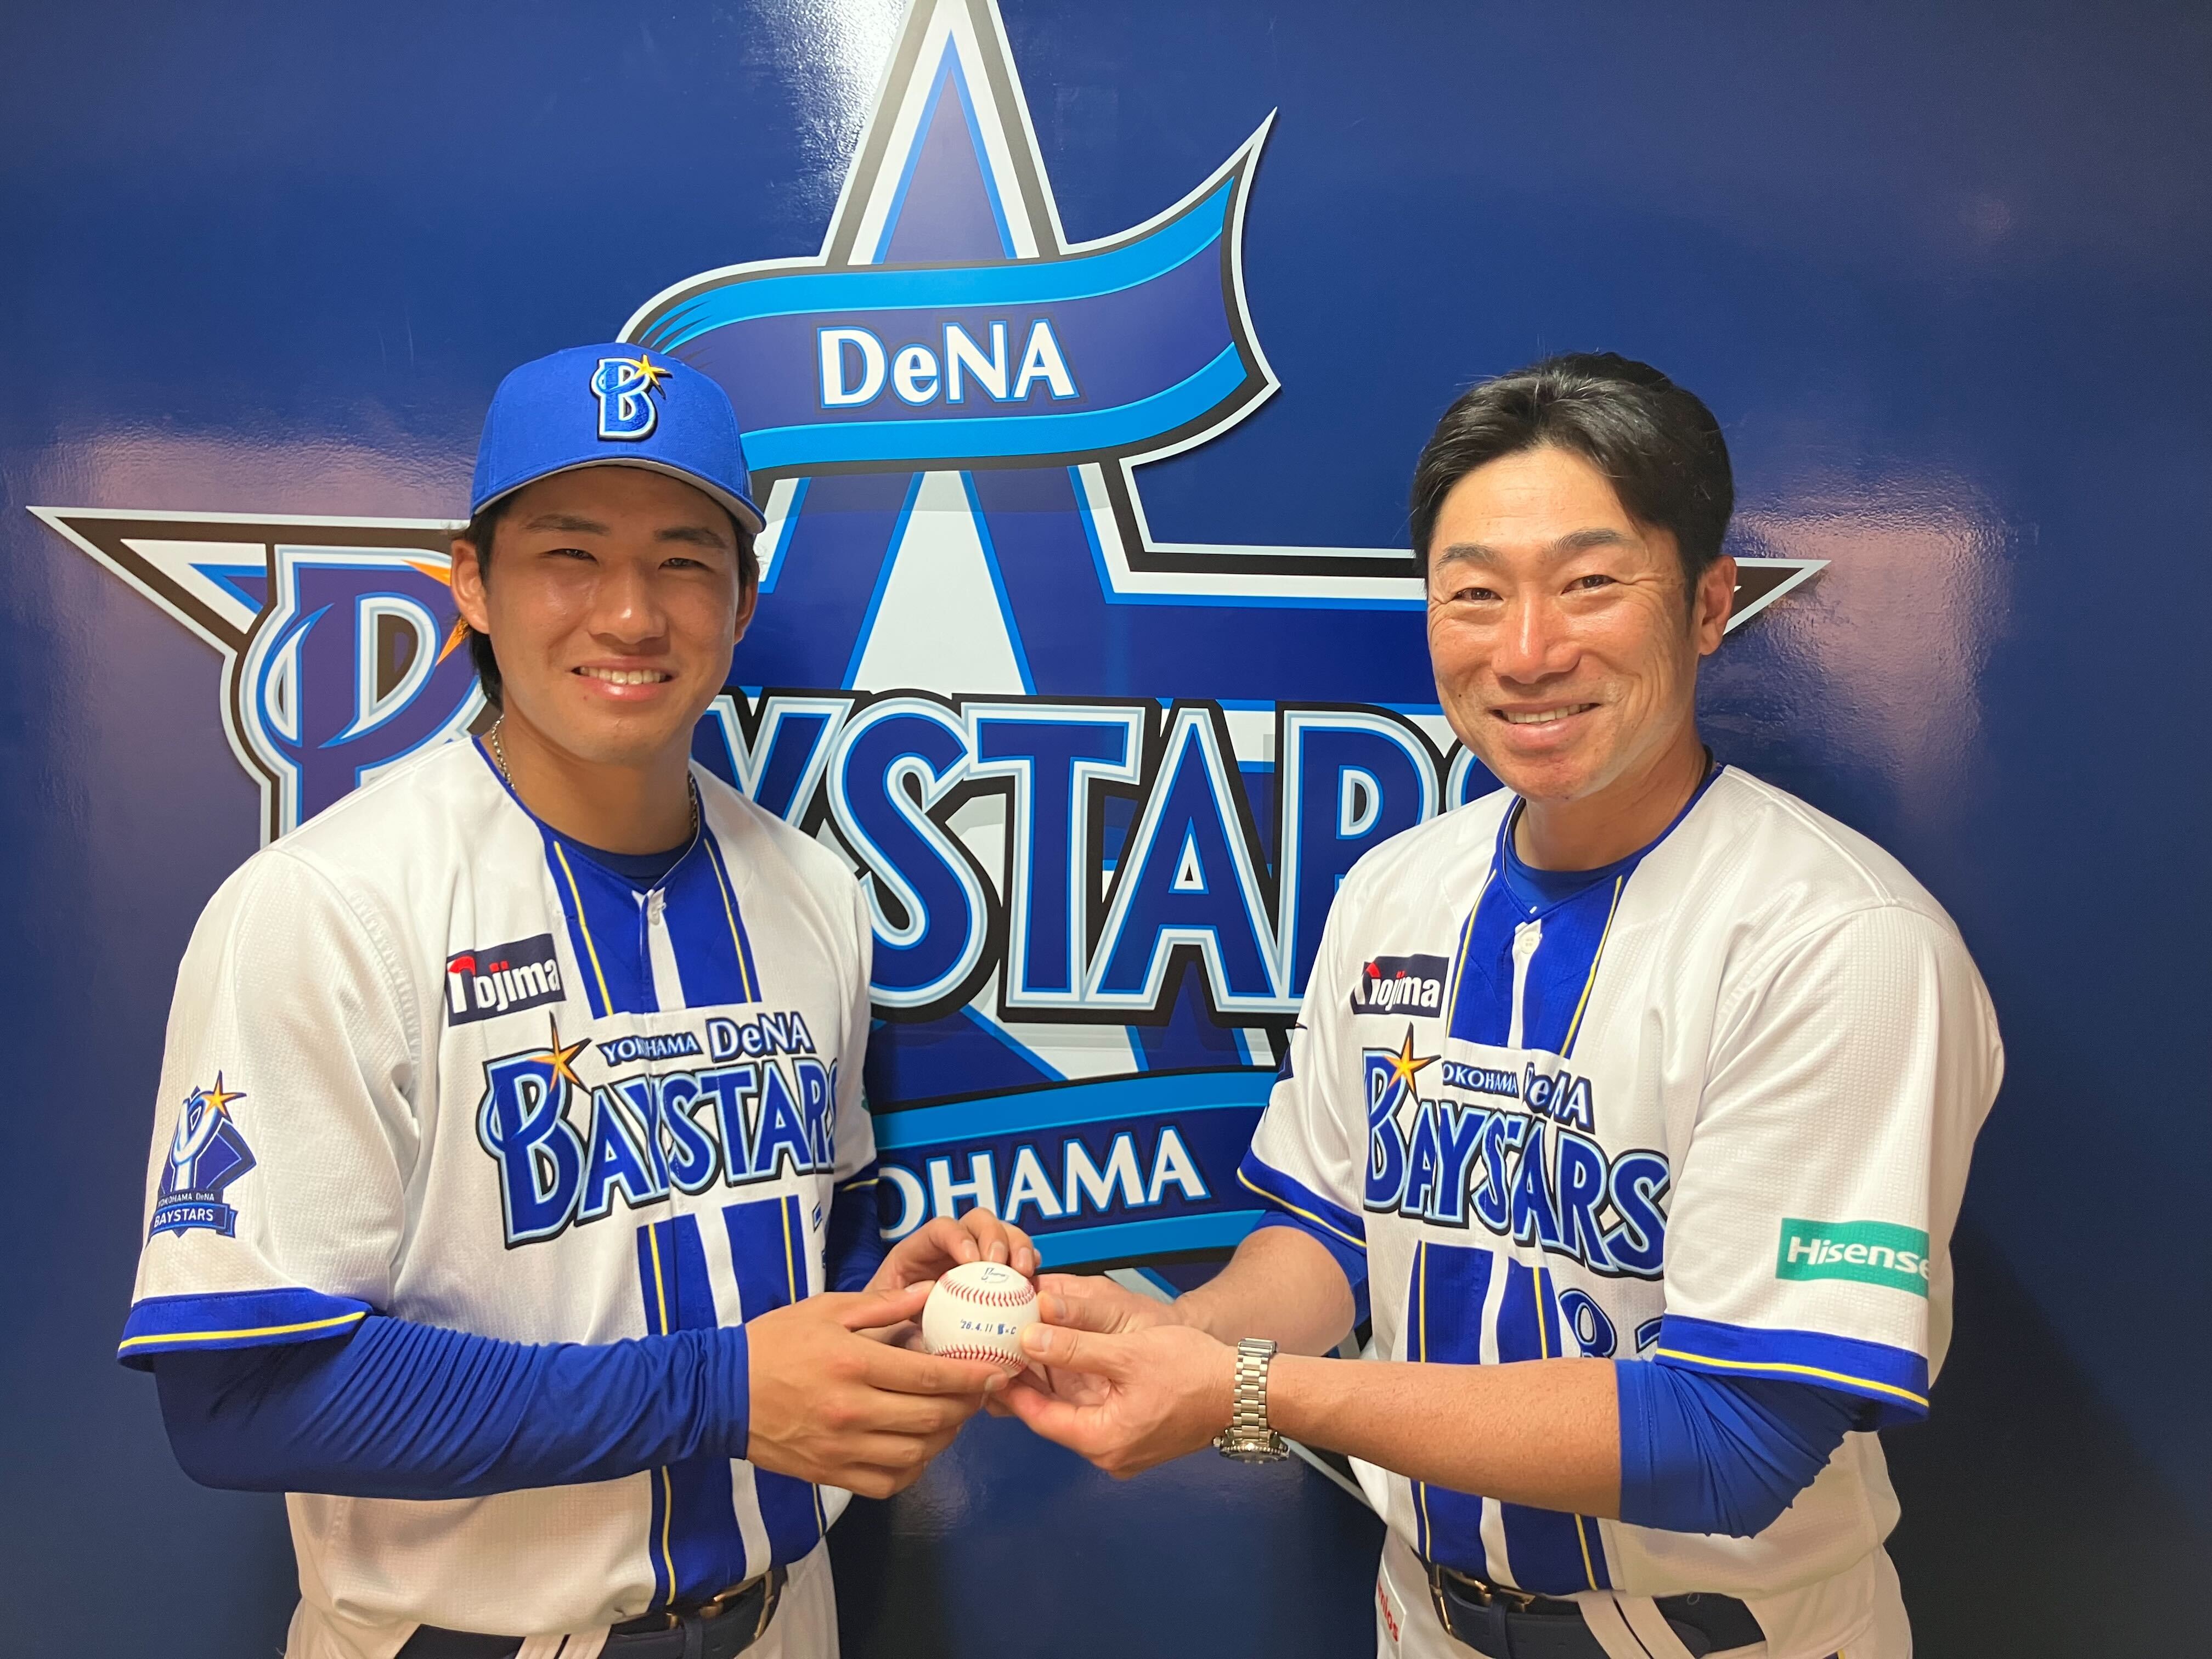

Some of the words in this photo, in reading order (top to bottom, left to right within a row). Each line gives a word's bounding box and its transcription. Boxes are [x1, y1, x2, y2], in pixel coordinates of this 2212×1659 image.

[817, 318, 1080, 408] DeNA
[708, 1013, 814, 1061] DeNA
[1442, 1062, 1518, 1095] OKOHAMA
[878, 1126, 1210, 1243] OHAMA
[1363, 1048, 1670, 1279] BAYSARS
[154, 1207, 213, 1228] BAYSTARS
[157, 1193, 193, 1207] YOKOHAMA
